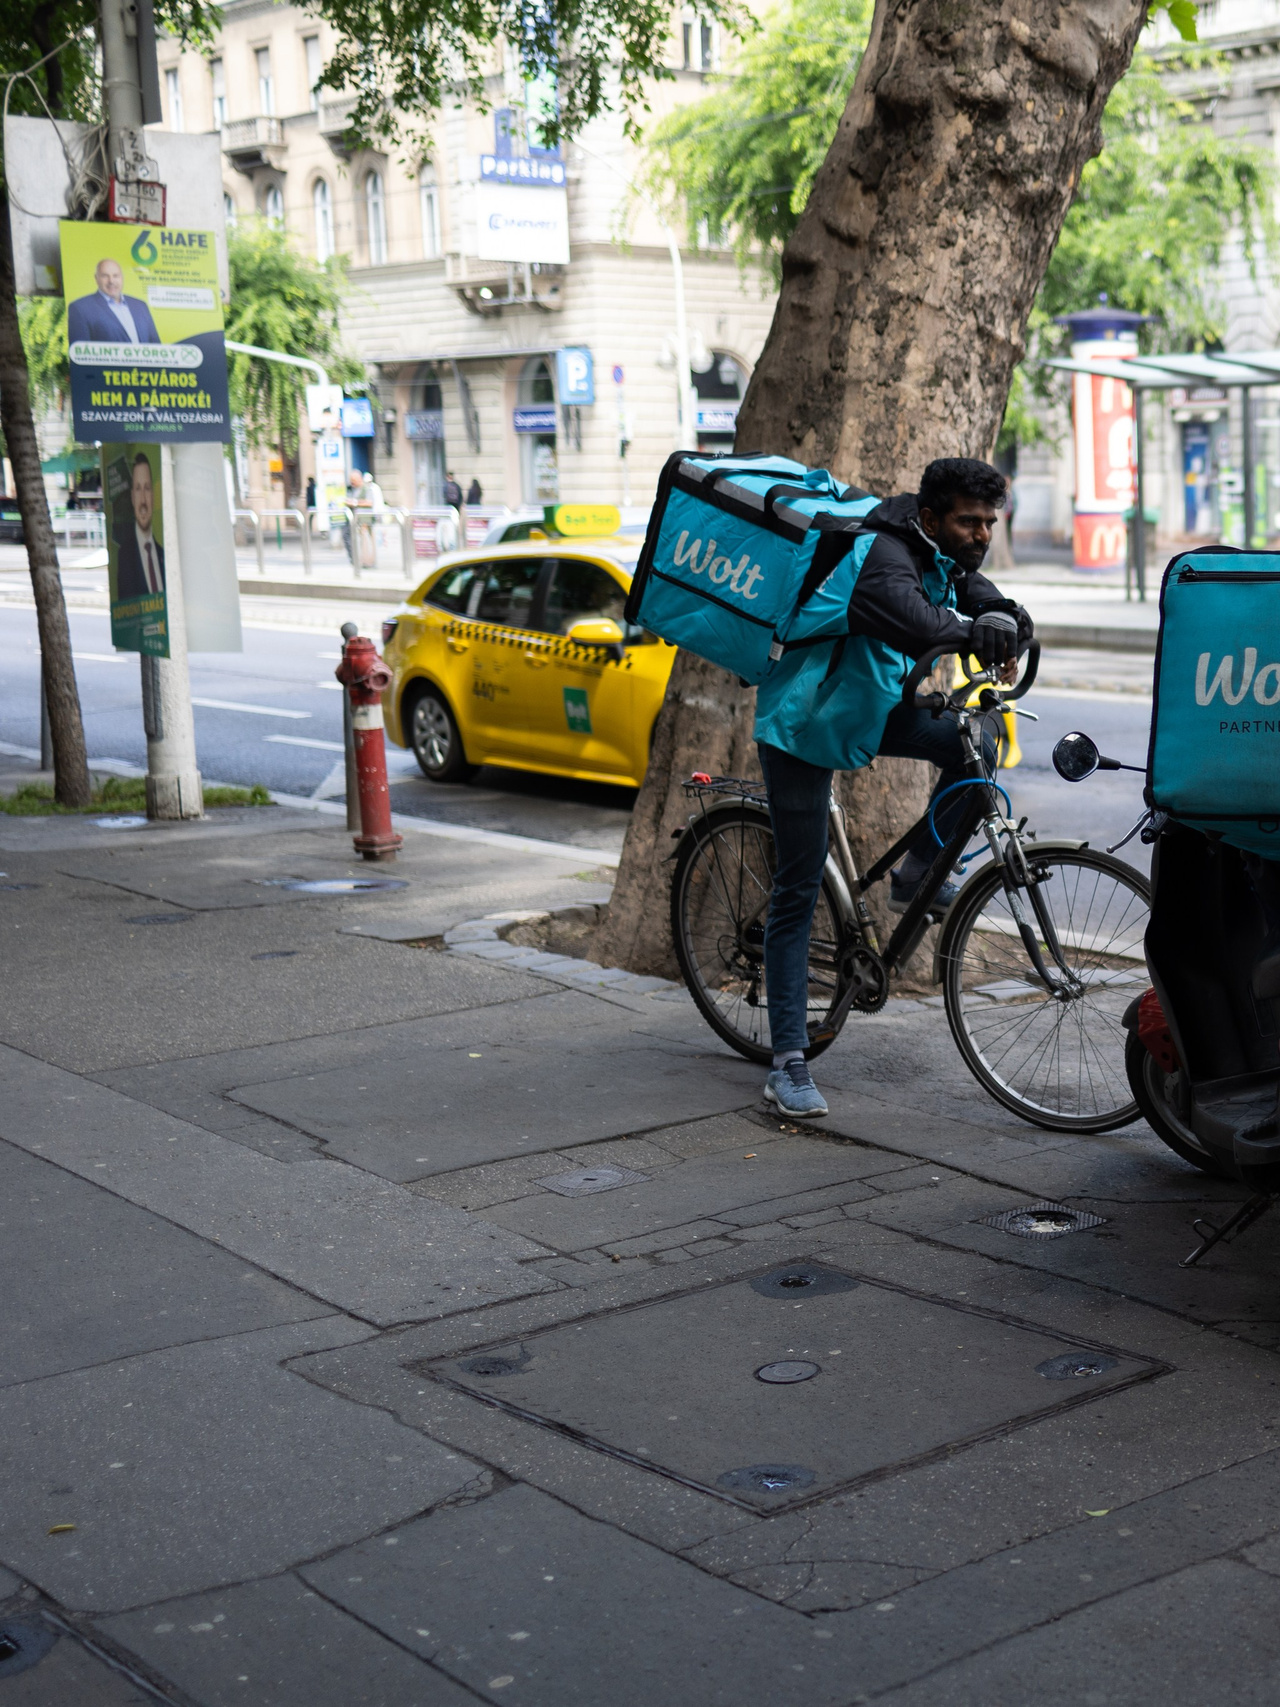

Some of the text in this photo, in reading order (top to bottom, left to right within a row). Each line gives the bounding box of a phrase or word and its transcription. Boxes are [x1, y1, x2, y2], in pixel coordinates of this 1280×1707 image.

[160, 231, 208, 249] HAFE
[74, 345, 177, 358] BÁLINT GYÖRGY
[103, 368, 198, 388] TERÉZVÁROS
[91, 389, 211, 409] NEM A PÁRTOKÉ!
[81, 411, 224, 424] SZAVAZZON A VÁLTOZÁSRA!
[673, 530, 765, 600] Wolt
